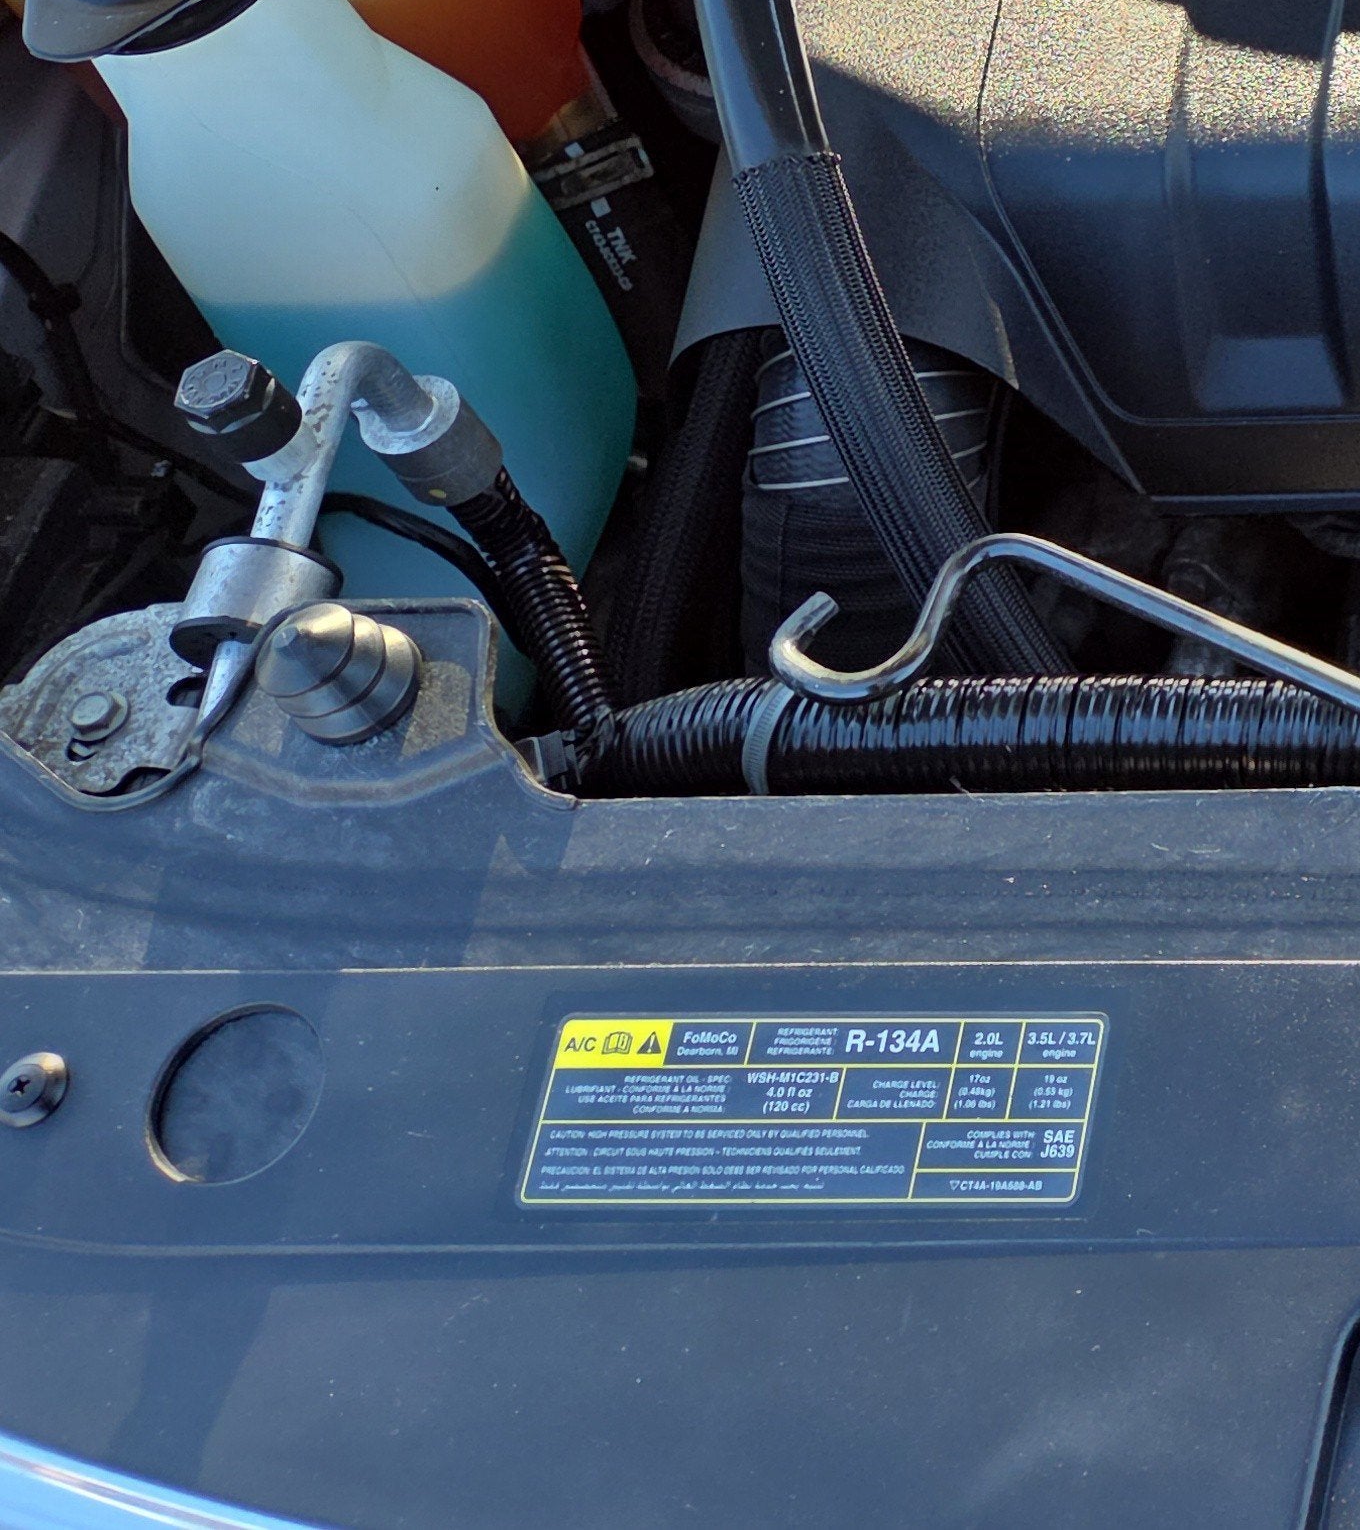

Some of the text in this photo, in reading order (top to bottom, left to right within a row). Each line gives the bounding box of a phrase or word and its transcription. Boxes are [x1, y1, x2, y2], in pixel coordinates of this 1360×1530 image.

[564, 1037, 596, 1052] A/C
[683, 1031, 737, 1045] FoMoCo
[845, 1029, 940, 1053] R-134A
[974, 1032, 1004, 1045] 2.0L
[1028, 1032, 1056, 1045] 3.5L
[1067, 1032, 1096, 1045] 3.7L
[677, 1046, 724, 1057] Dearborn,
[969, 1048, 1003, 1059] engine
[1042, 1048, 1077, 1059] engine
[747, 1072, 839, 1084] WSH-M1C231-B
[766, 1087, 786, 1098] 4.0
[799, 1089, 812, 1098] oz
[762, 1101, 810, 1114] (120 cc)
[1043, 1130, 1075, 1143] SAE
[1040, 1144, 1075, 1158] J639
